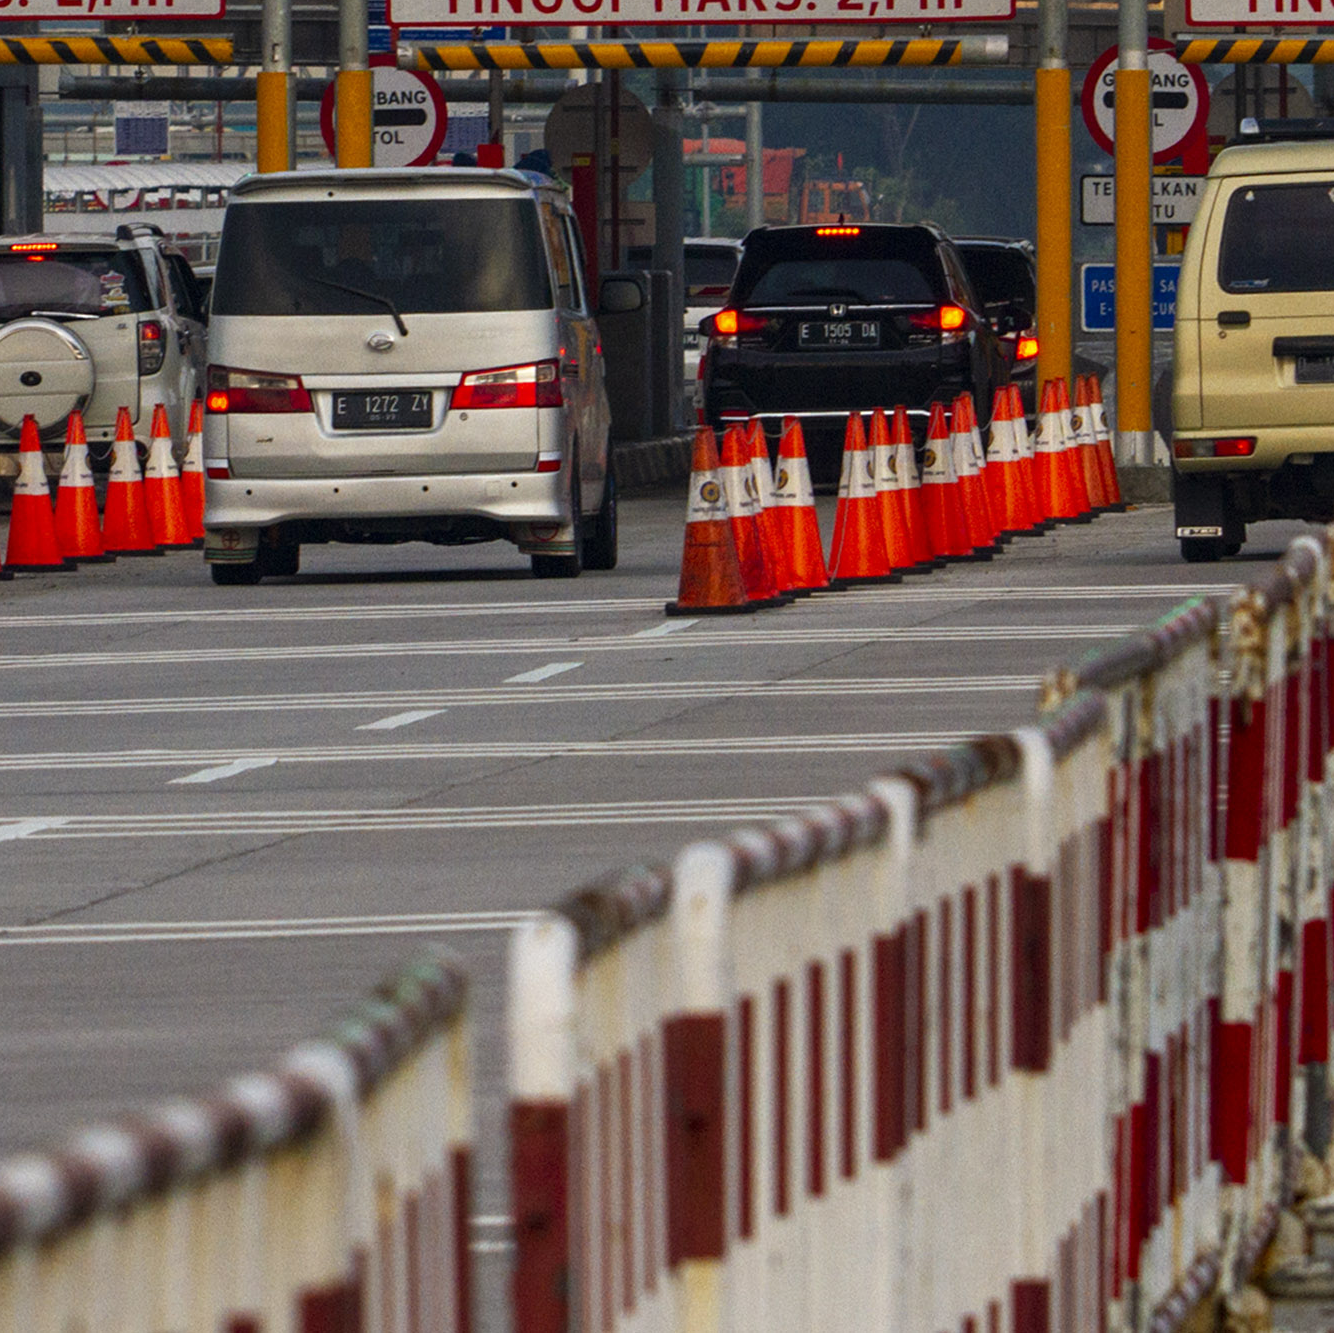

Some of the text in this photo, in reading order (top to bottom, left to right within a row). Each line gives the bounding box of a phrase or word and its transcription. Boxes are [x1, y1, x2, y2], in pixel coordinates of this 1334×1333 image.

[802, 323, 877, 339] E 1505 DA
[337, 394, 429, 414] E 1272 ZY
